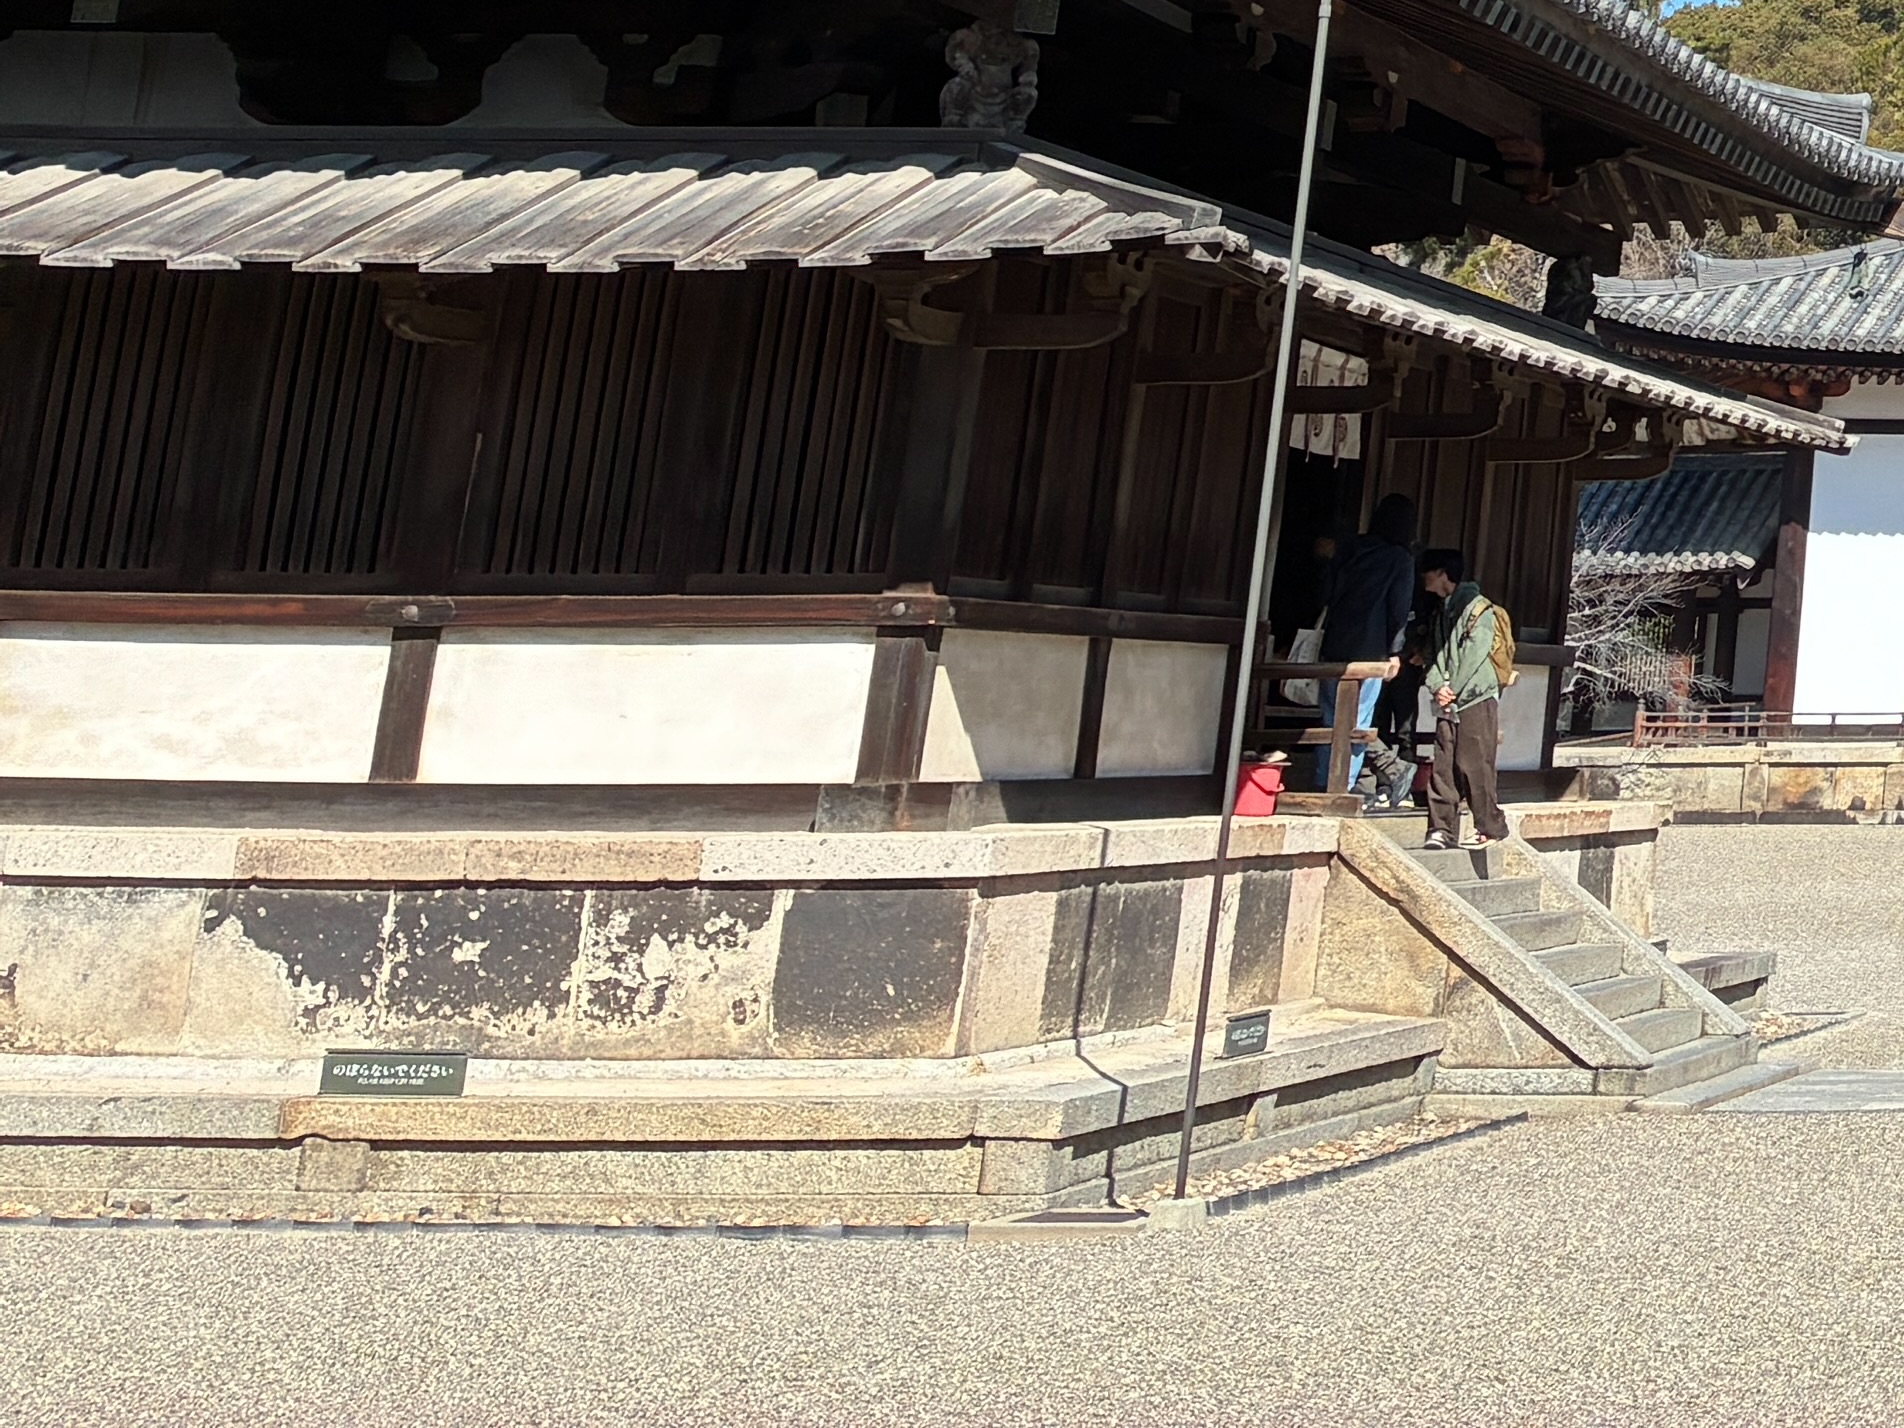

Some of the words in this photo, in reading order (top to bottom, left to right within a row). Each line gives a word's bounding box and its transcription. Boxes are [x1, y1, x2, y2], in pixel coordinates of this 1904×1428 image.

[332, 1063, 454, 1078] のぼらないでください
